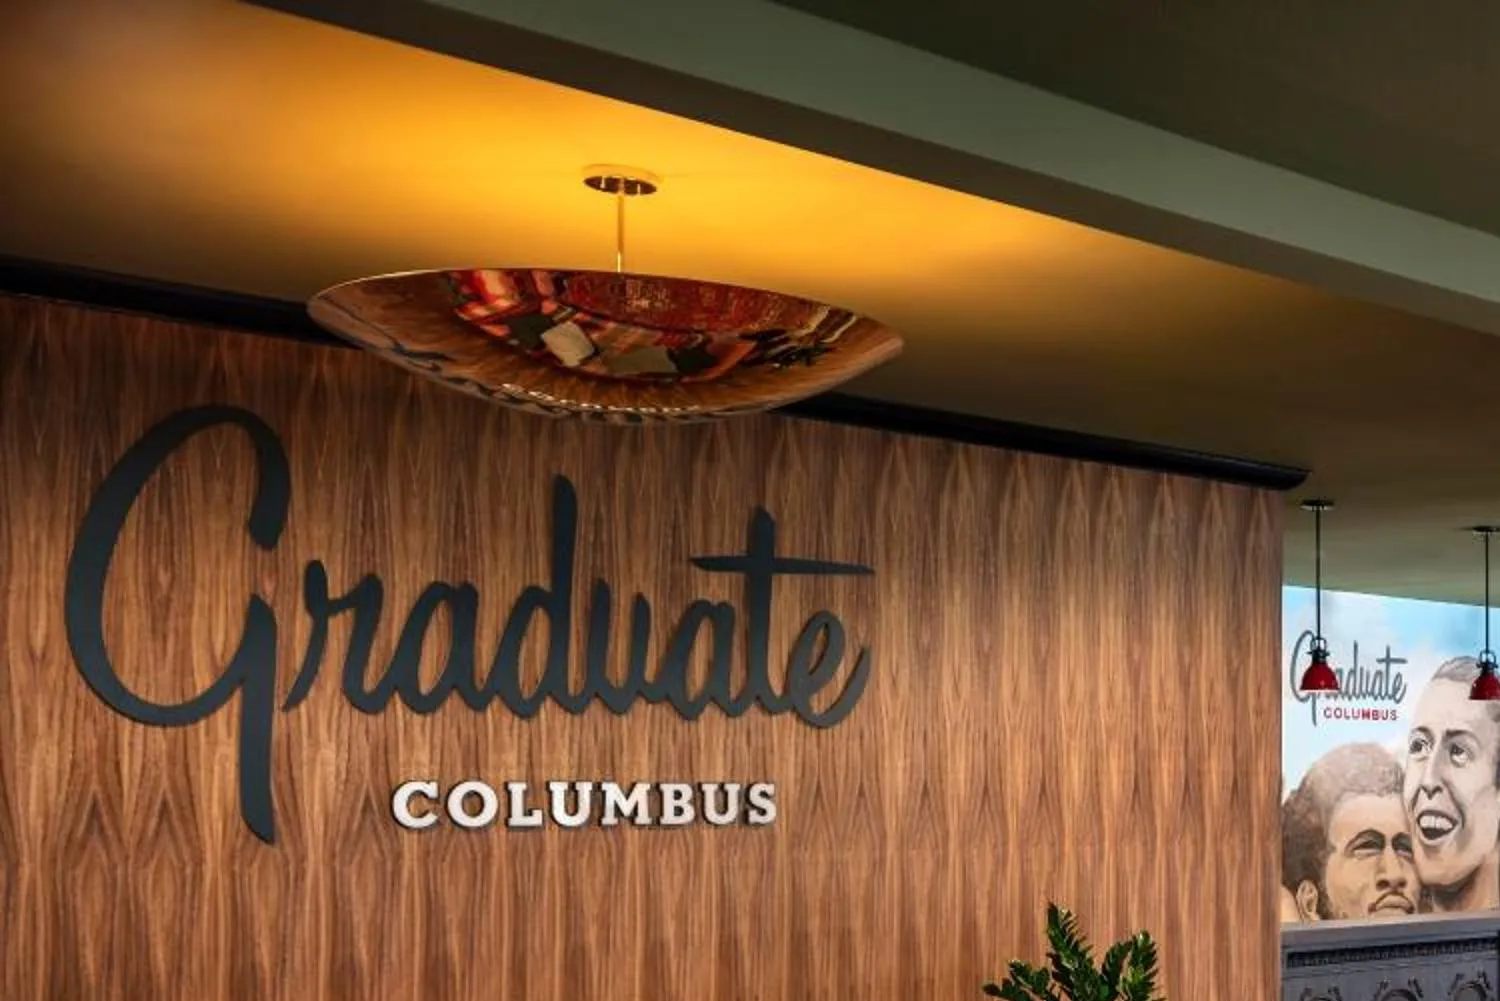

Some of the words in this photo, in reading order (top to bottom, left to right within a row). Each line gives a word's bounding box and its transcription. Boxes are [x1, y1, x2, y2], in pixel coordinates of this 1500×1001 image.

[64, 405, 876, 844] Graduate
[1290, 630, 1408, 726] Gaduate
[1323, 707, 1398, 720] COLUMBUS
[391, 779, 778, 830] COLUMBUS
